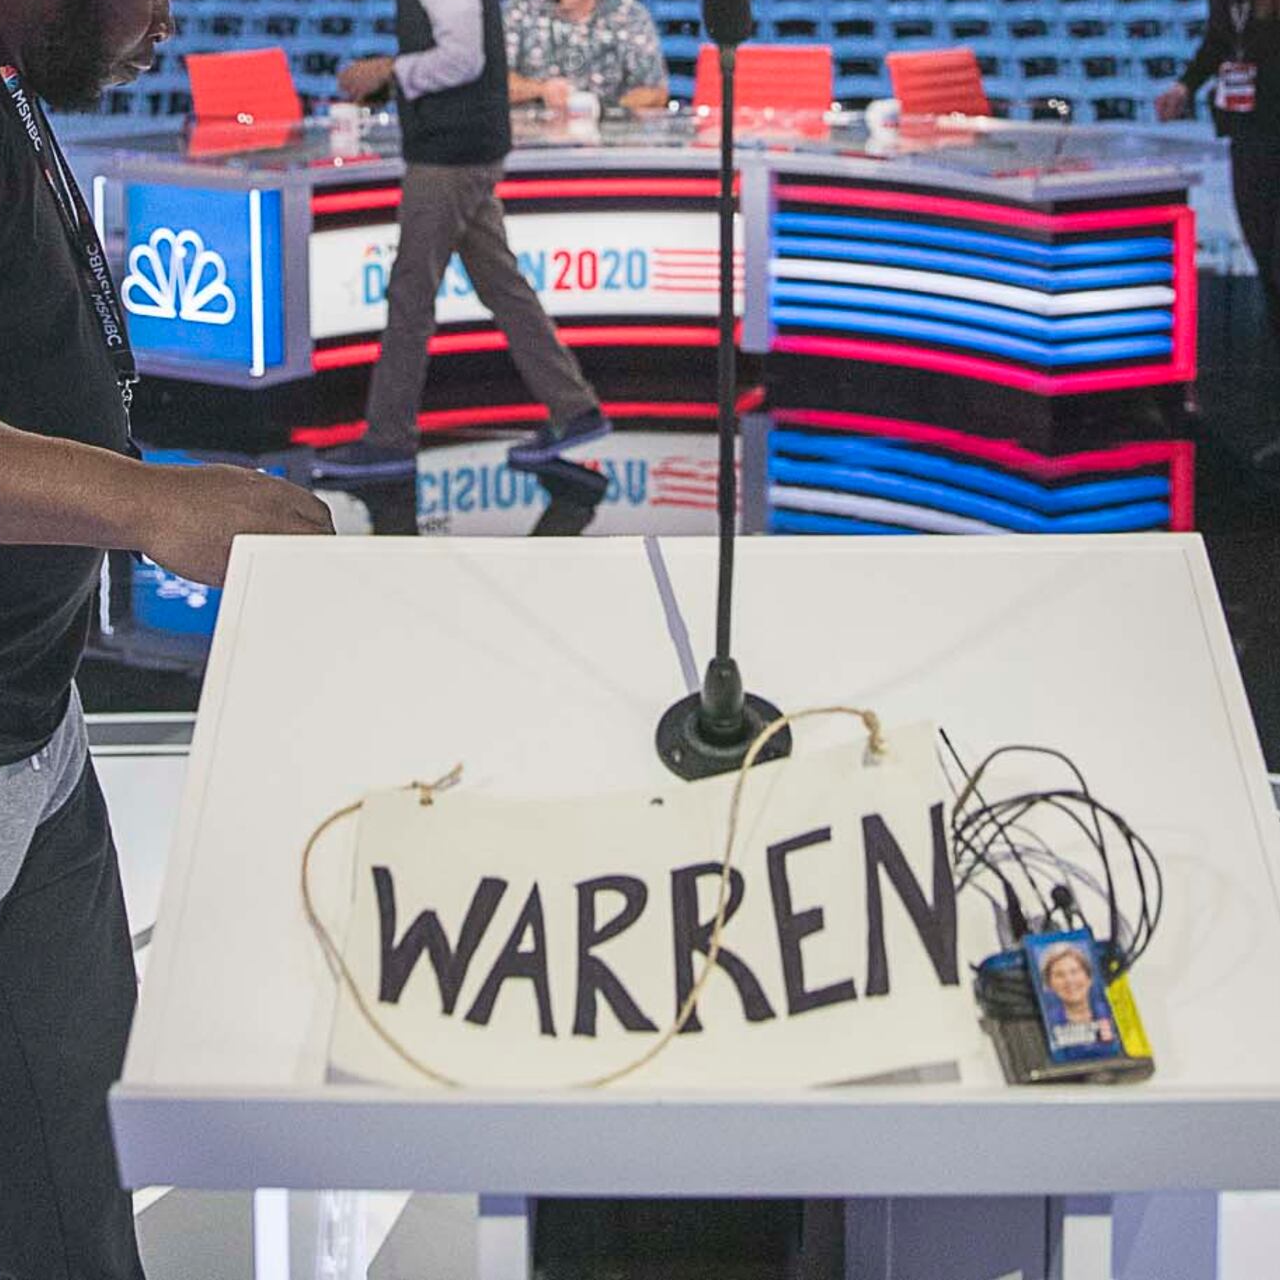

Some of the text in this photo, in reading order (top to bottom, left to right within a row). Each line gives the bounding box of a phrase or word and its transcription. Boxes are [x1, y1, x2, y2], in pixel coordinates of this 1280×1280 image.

[11, 88, 44, 152] MSNBC
[552, 248, 649, 291] 2020
[91, 293, 122, 347] MSNBC
[370, 801, 960, 1038] WARREN
